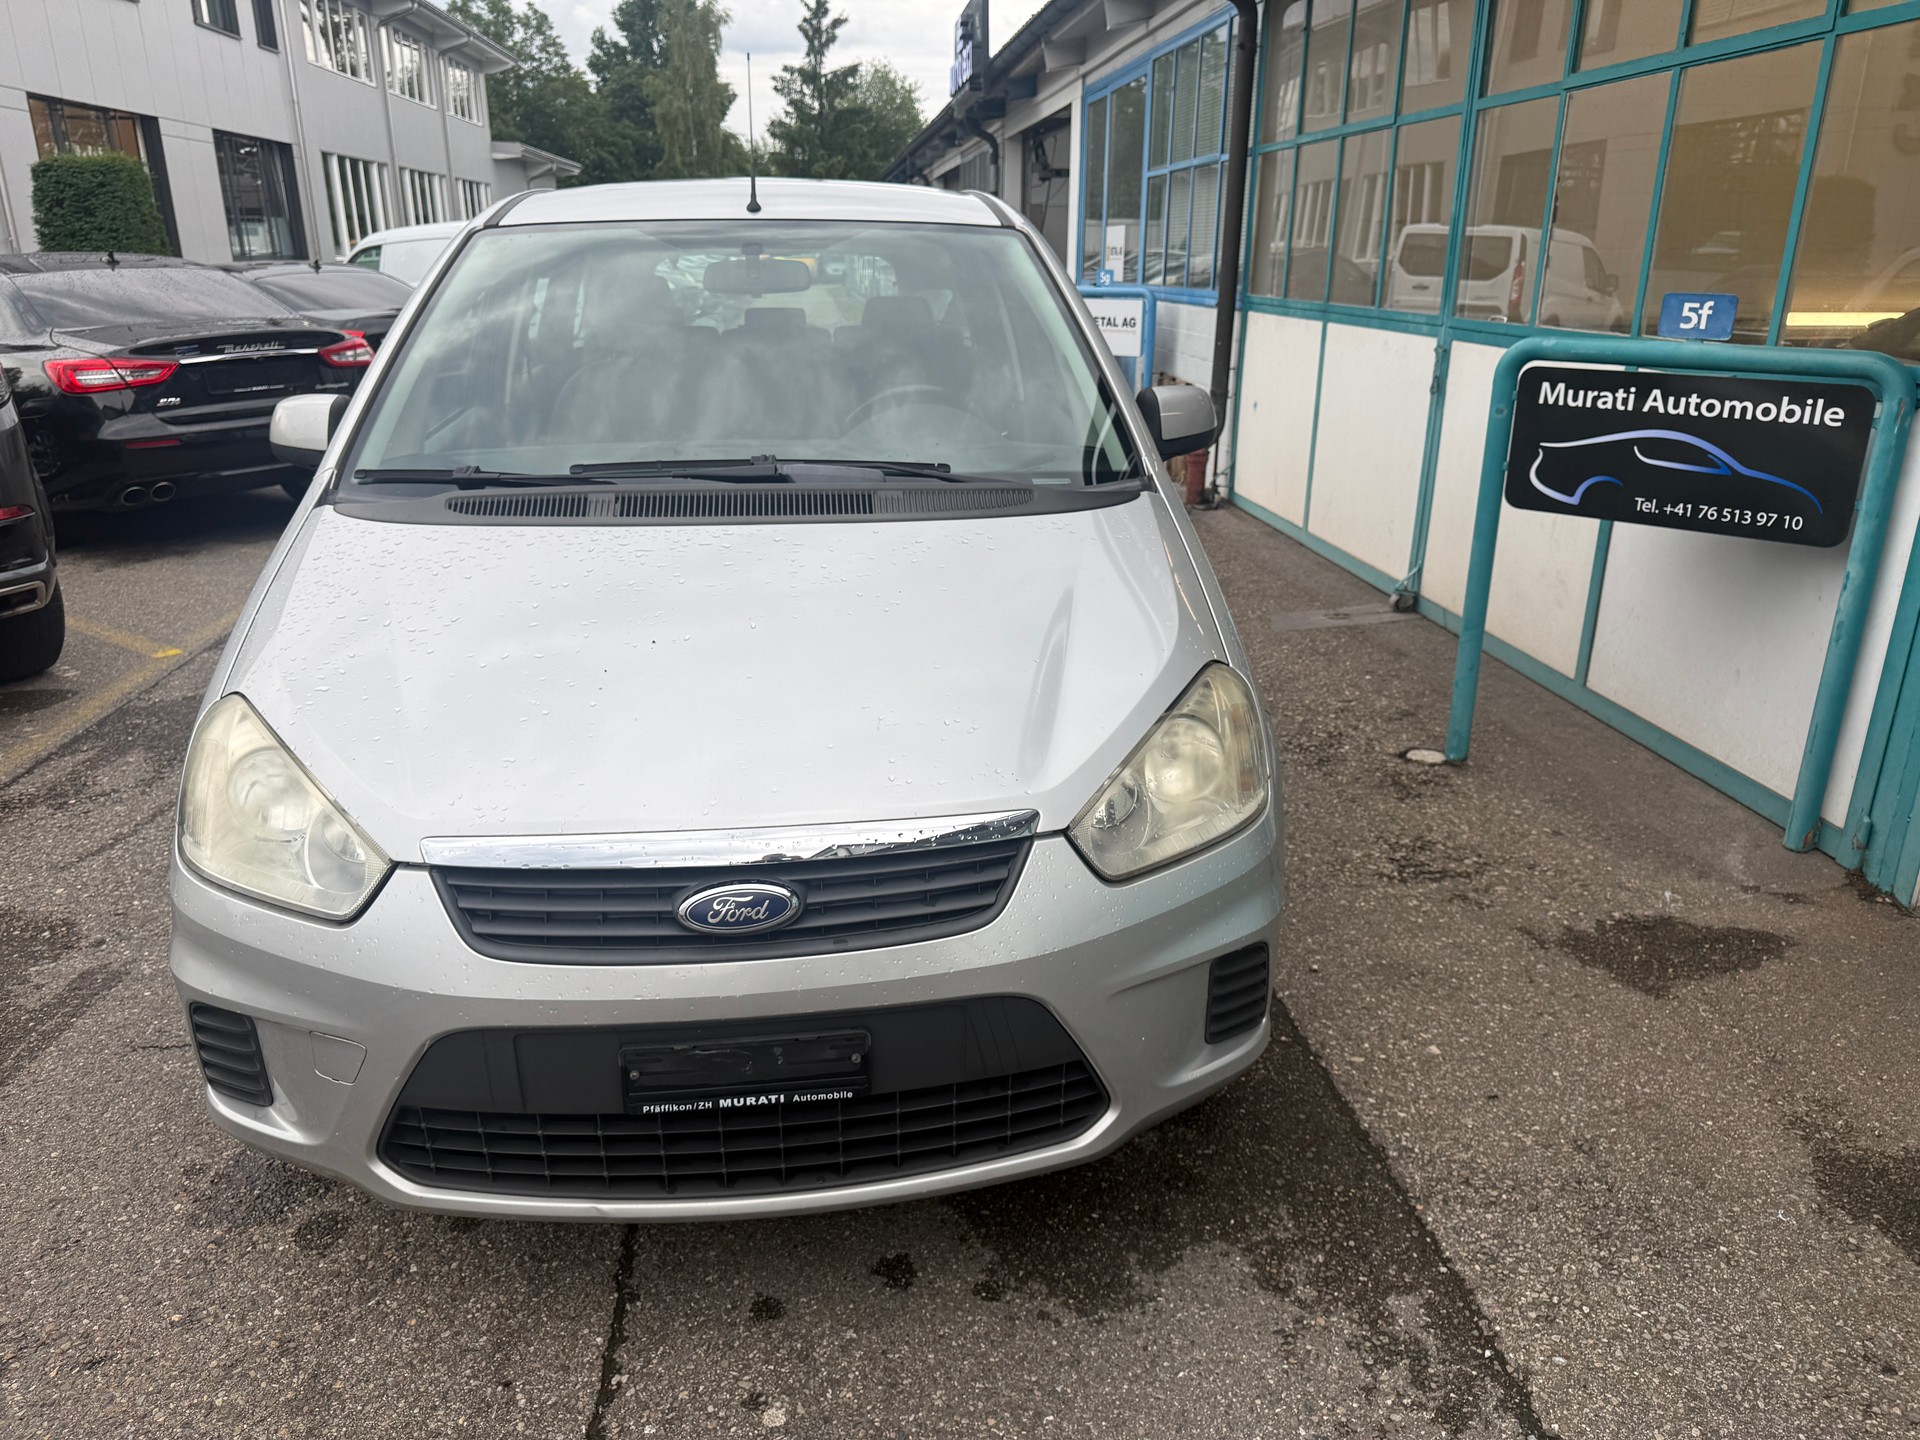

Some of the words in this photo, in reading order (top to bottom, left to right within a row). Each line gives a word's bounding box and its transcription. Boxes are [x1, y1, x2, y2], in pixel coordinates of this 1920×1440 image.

[1121, 317, 1137, 328] AG
[1679, 301, 1715, 330] 5f
[1539, 382, 1636, 411] Murati
[1642, 389, 1844, 426] Automobile
[1635, 497, 1659, 513] Tel.
[1664, 503, 1691, 517] +41
[1699, 505, 1717, 520] 76
[1721, 508, 1751, 524] 513
[1757, 512, 1778, 526] 97
[1784, 516, 1803, 530] 10
[707, 895, 770, 924] Ford
[643, 1102, 712, 1113] Pfäffikon/ZH
[719, 1094, 784, 1107] MURATI
[793, 1091, 852, 1101] Automobile
